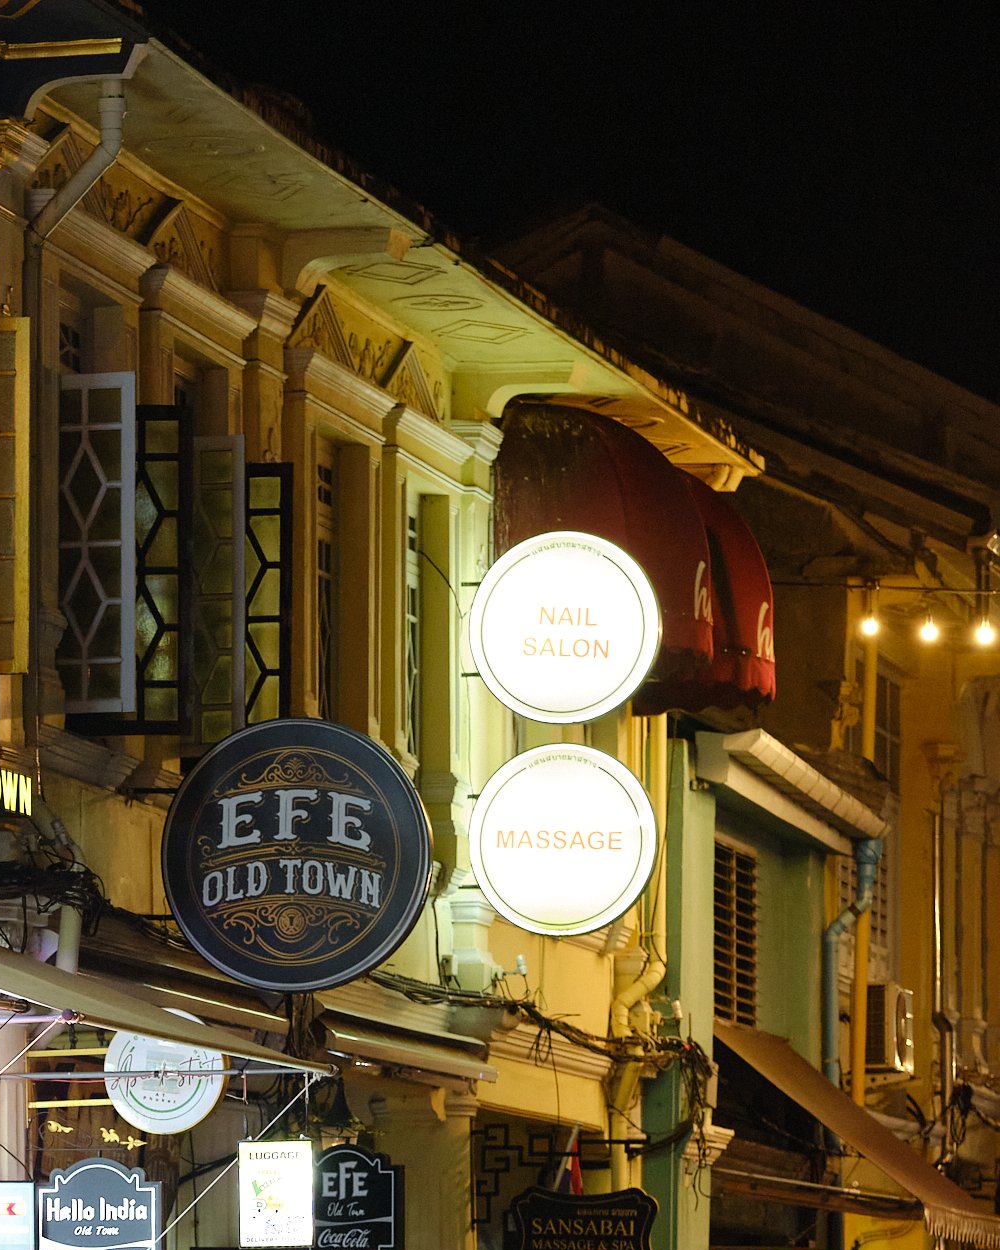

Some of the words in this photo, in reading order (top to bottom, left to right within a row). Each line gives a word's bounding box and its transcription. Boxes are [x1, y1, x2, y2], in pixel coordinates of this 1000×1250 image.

[538, 605, 598, 627] NAIL
[522, 636, 610, 659] SALON
[217, 788, 372, 852] EFE
[495, 829, 623, 851] MASSAGE
[202, 860, 268, 908] OLD
[279, 859, 381, 909] TOWN
[321, 1160, 369, 1201] EFE
[46, 1197, 95, 1221] Hello
[99, 1196, 148, 1221] India
[327, 1202, 344, 1216] Old
[347, 1201, 365, 1217] Town
[74, 1226, 93, 1236] Old
[317, 1228, 372, 1248] Coca-Cola
[531, 1218, 635, 1236] SANSABAI
[531, 1239, 594, 1250] MASSAGE
[599, 1240, 609, 1250] &
[611, 1239, 635, 1250] SPA
